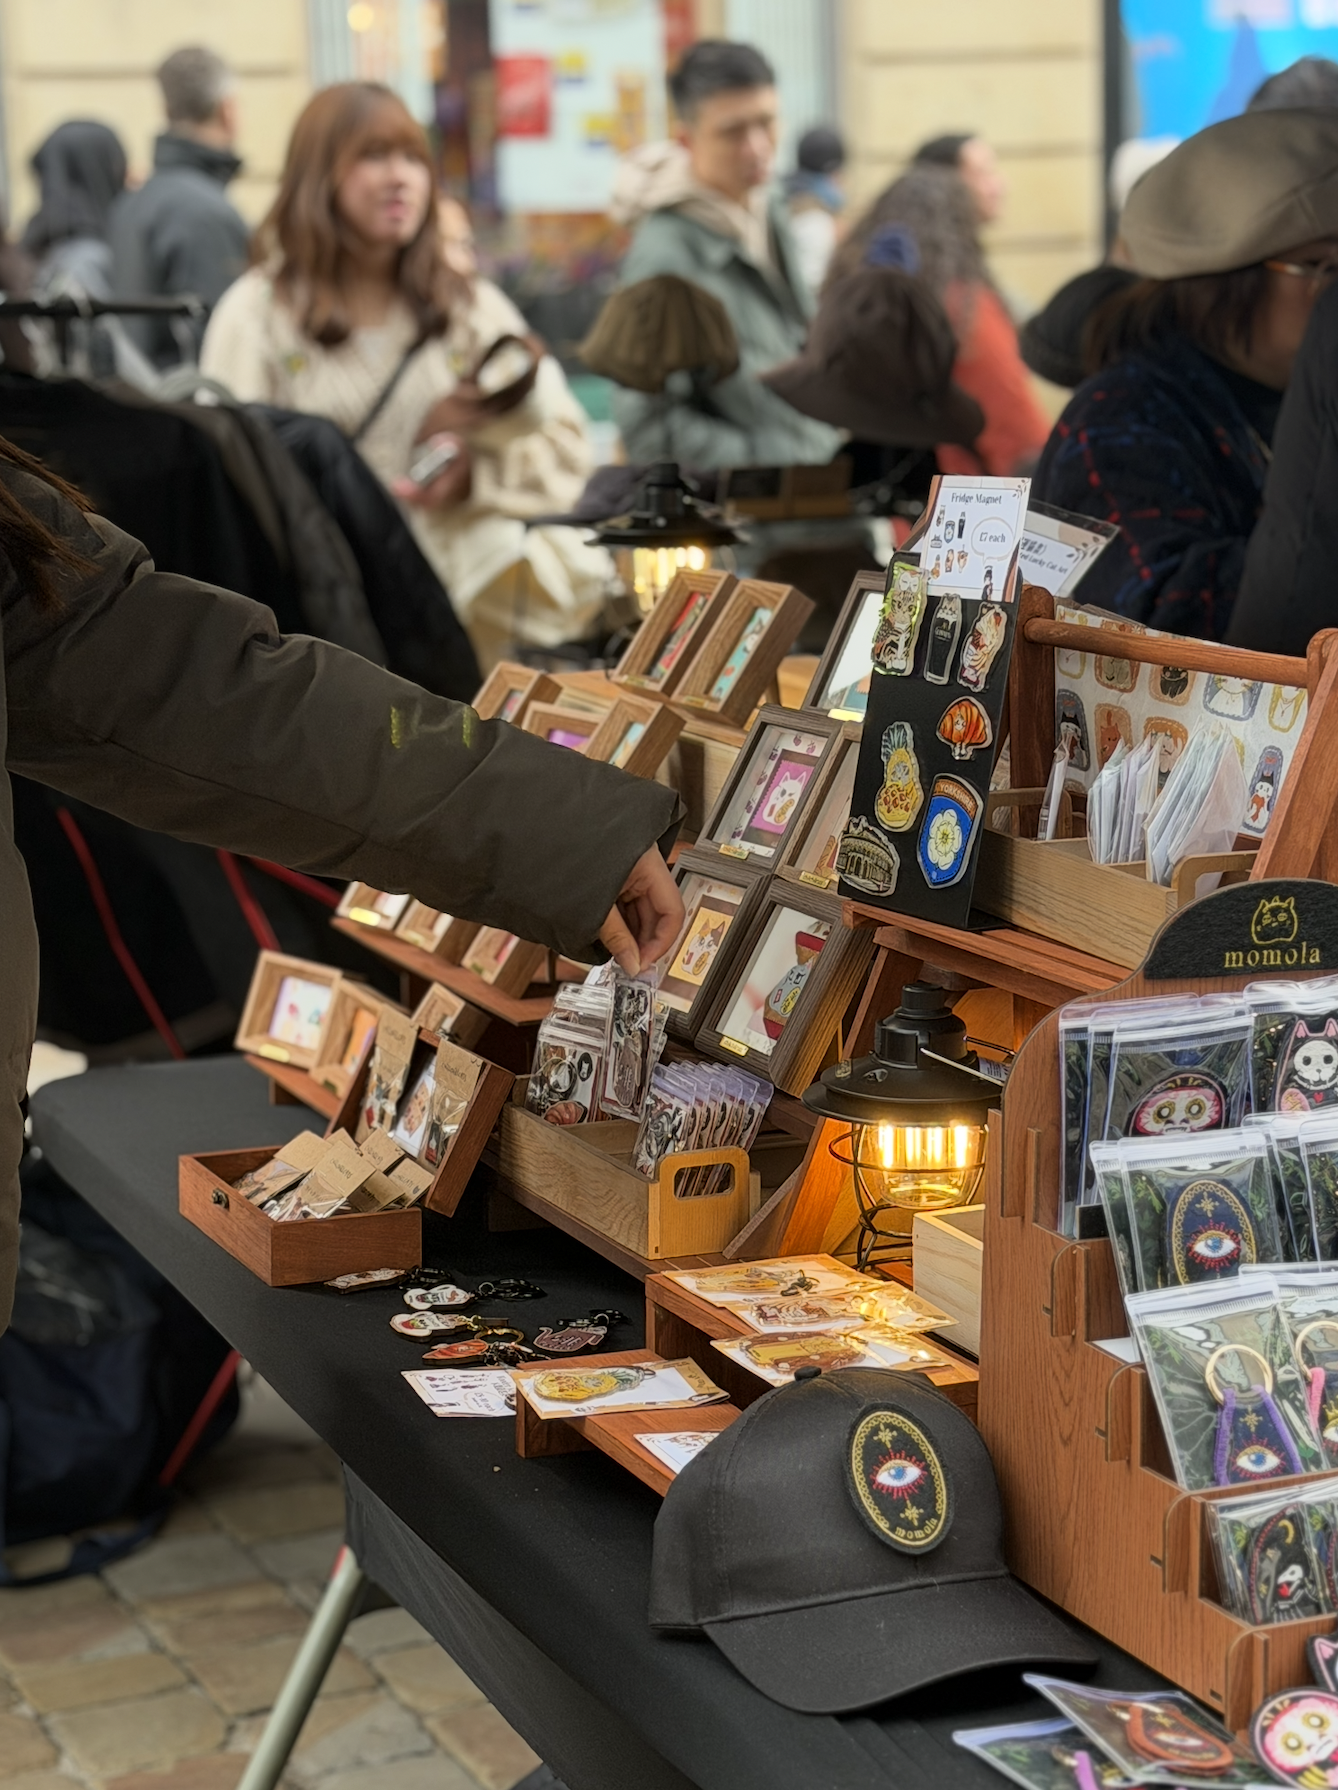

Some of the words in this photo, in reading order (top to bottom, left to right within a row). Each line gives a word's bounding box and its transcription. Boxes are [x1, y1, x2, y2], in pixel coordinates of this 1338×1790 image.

[951, 492, 974, 506] Fridge
[975, 493, 1002, 506] Magnet
[979, 531, 989, 542] £7
[989, 533, 1006, 543] each
[939, 783, 976, 812] YORKSHIRE
[1224, 941, 1321, 969] momola
[895, 1516, 938, 1539] momola
